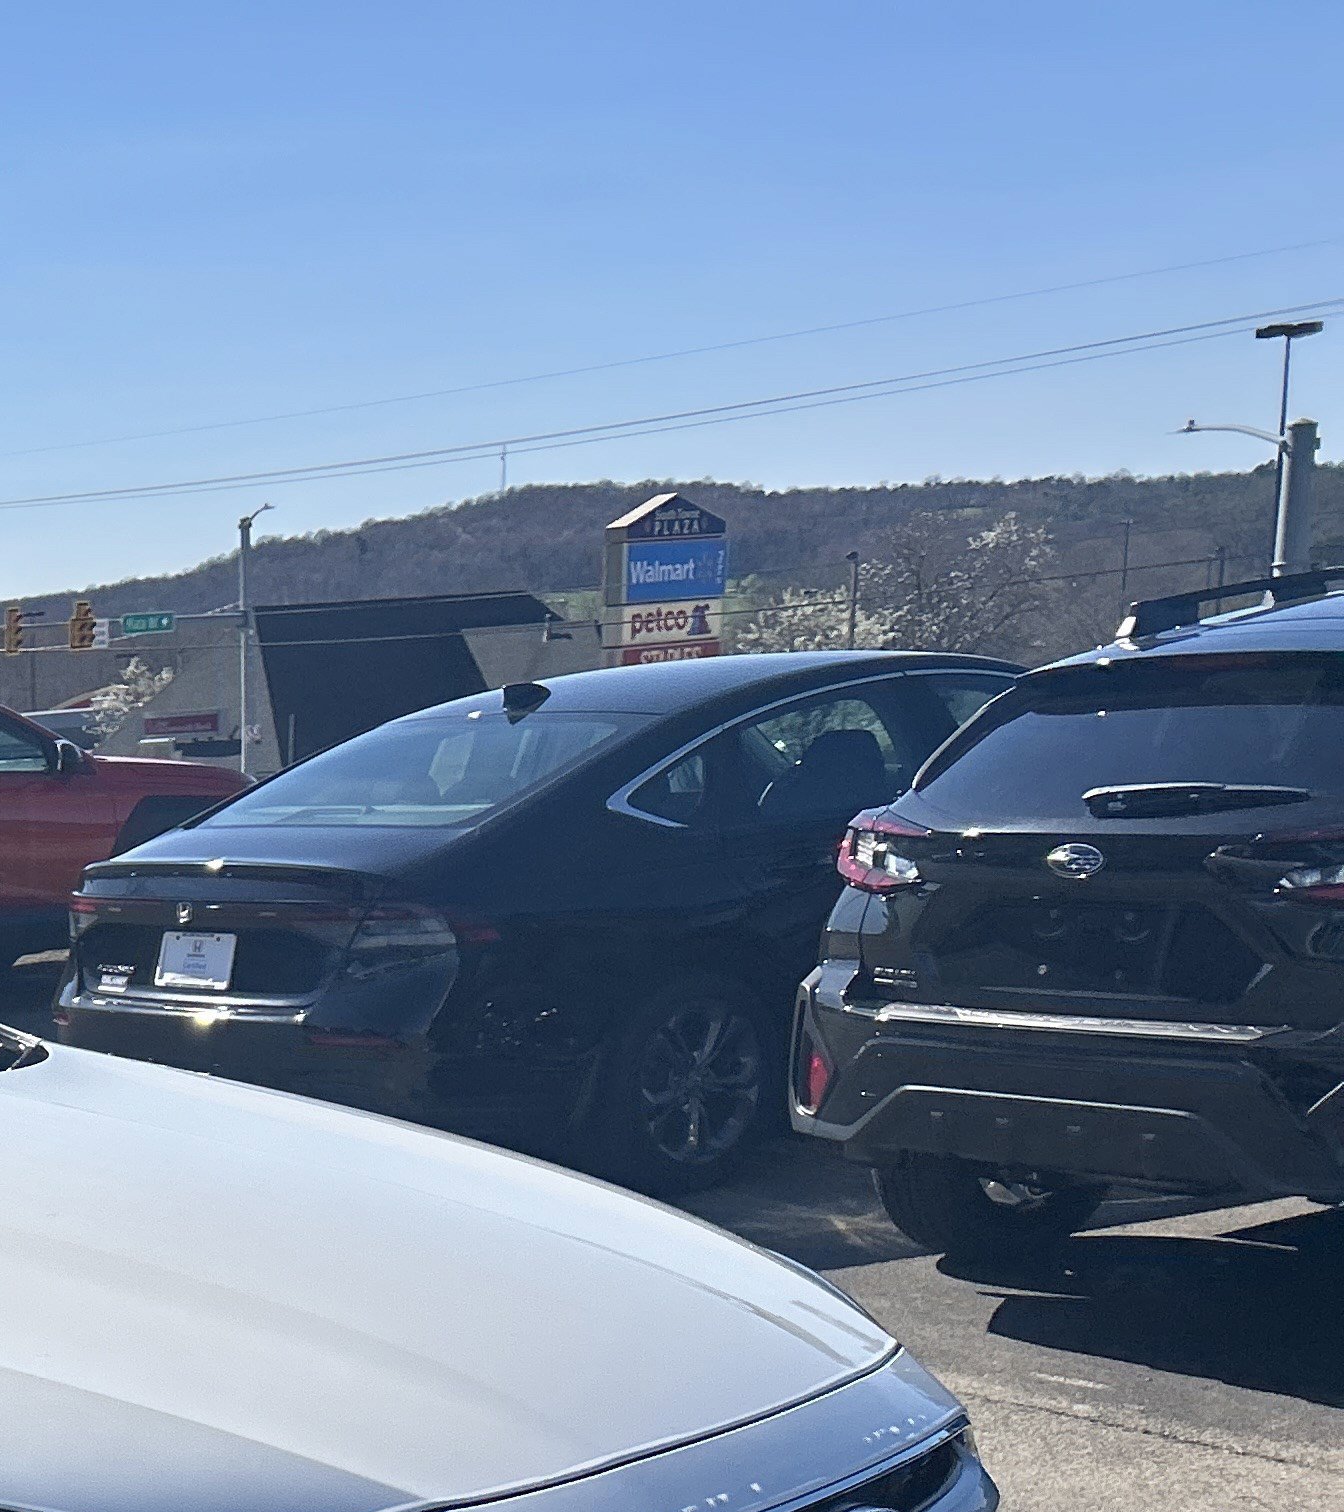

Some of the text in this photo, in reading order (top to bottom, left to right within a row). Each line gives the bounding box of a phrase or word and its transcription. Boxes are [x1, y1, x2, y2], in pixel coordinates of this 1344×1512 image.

[653, 519, 701, 536] PLAZA
[630, 558, 695, 584] Walmart
[630, 606, 689, 640] petco
